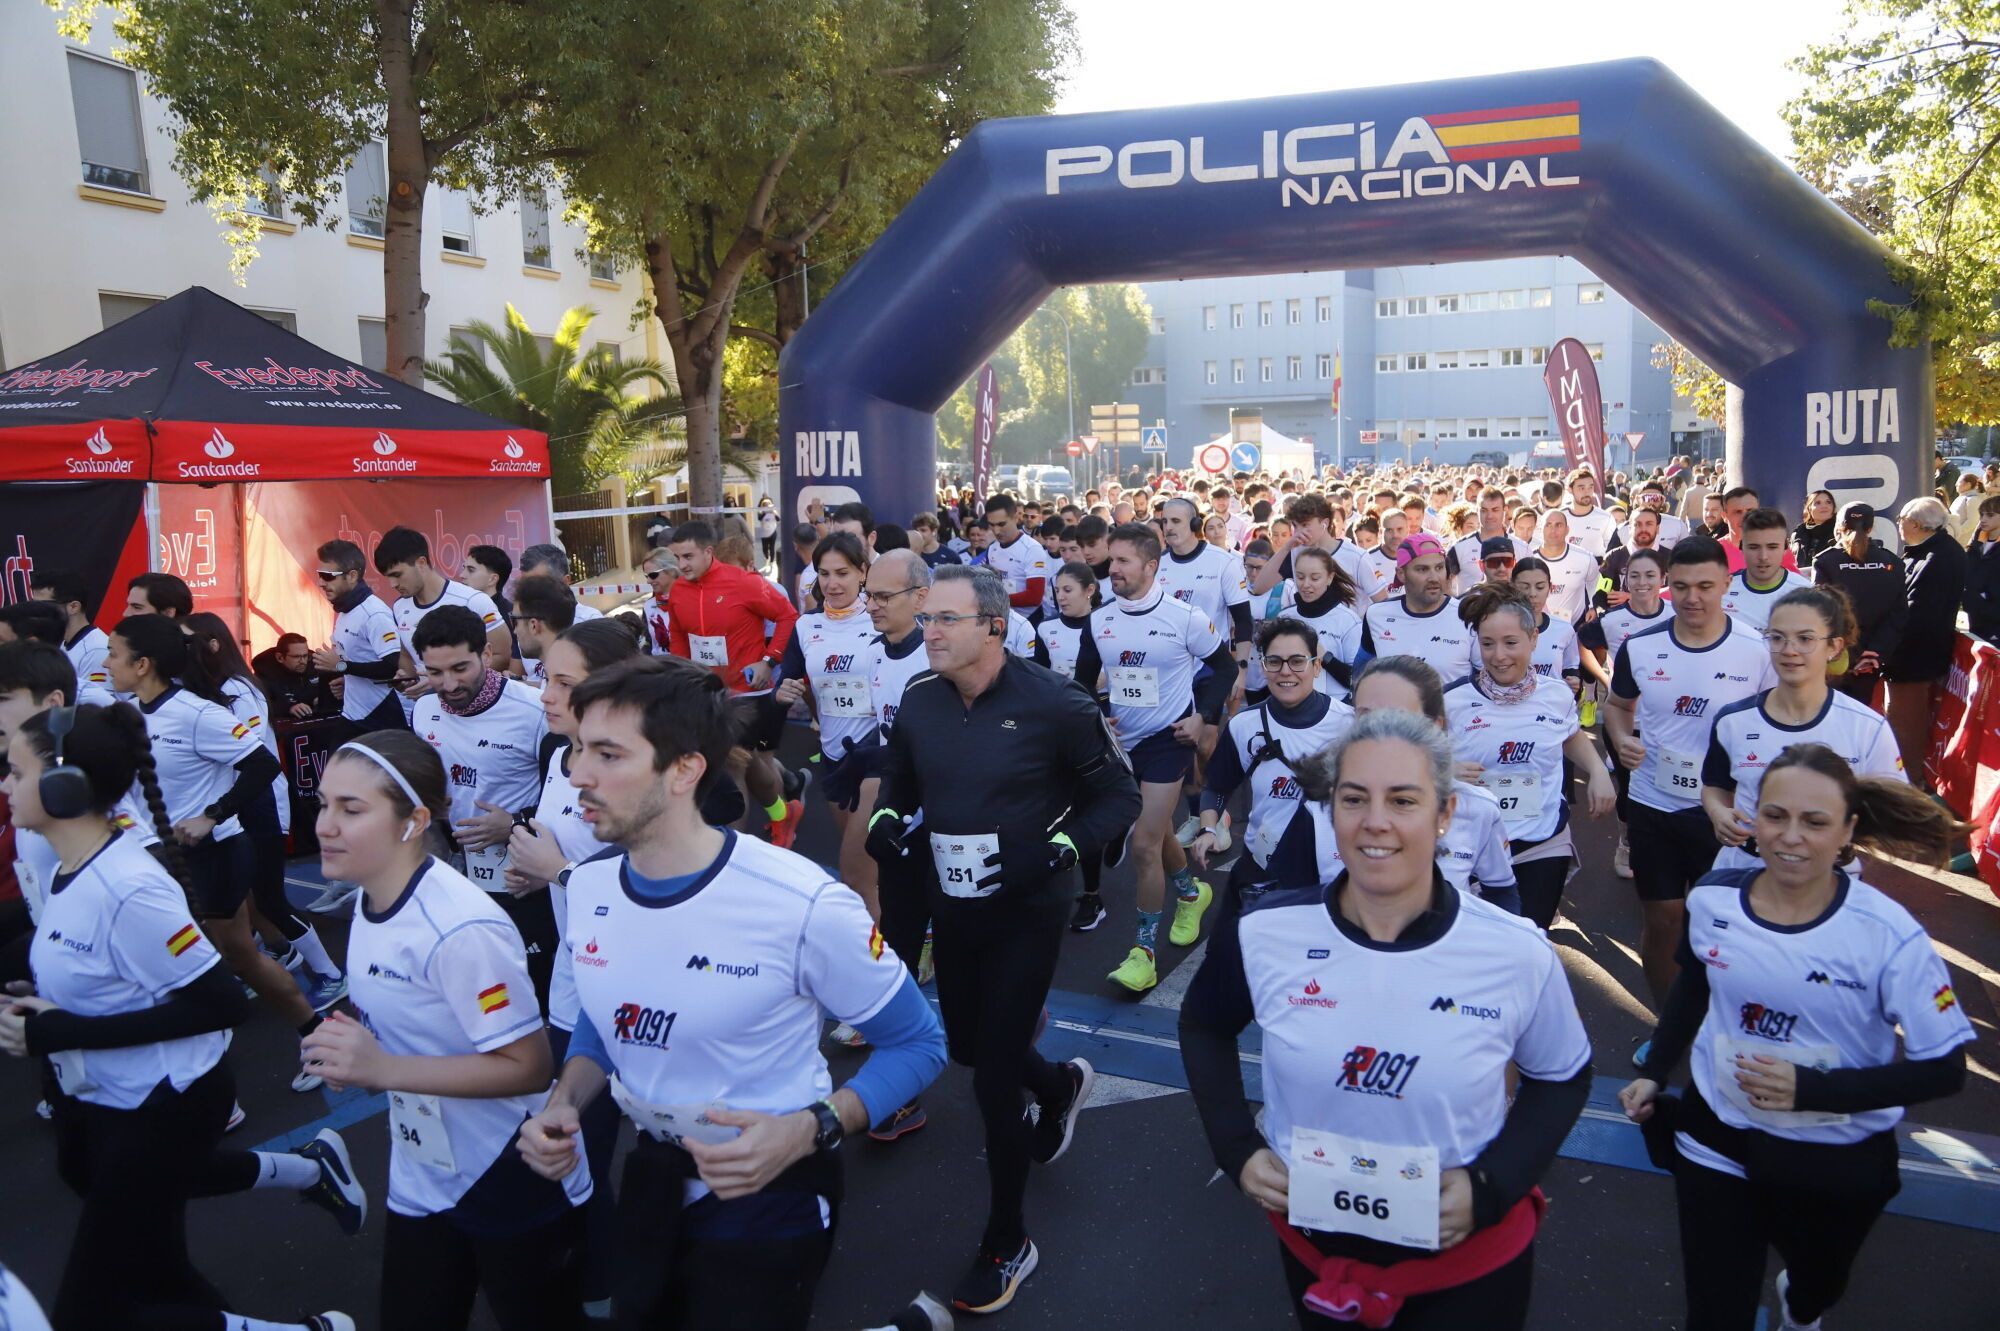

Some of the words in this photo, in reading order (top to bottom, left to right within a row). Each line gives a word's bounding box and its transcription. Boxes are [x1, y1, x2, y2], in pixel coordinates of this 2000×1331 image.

[1282, 157, 1580, 207] NACIONAL
[194, 357, 383, 395] Evedeport
[265, 400, 402, 411] www.evedeport.es
[1806, 388, 1899, 447] RUTA
[796, 431, 862, 477] RUTA
[66, 457, 133, 473] Santander
[178, 460, 260, 478] Santander
[353, 457, 416, 472] Santander
[489, 459, 541, 472] Santander
[1122, 688, 1142, 698] 155
[834, 697, 854, 708] 154
[1497, 741, 1536, 763] R091
[1672, 774, 1698, 789] 583
[1499, 797, 1519, 809] 67
[474, 866, 494, 880] 827
[946, 867, 974, 883] 251
[63, 938, 94, 953] mupol
[575, 953, 609, 968] Santander
[716, 963, 759, 979] mupol
[1288, 995, 1338, 1009] Santander
[1461, 1005, 1501, 1020] mupol
[614, 1002, 677, 1045] R091
[1335, 1046, 1421, 1093] R091
[1333, 1190, 1390, 1220] 666
